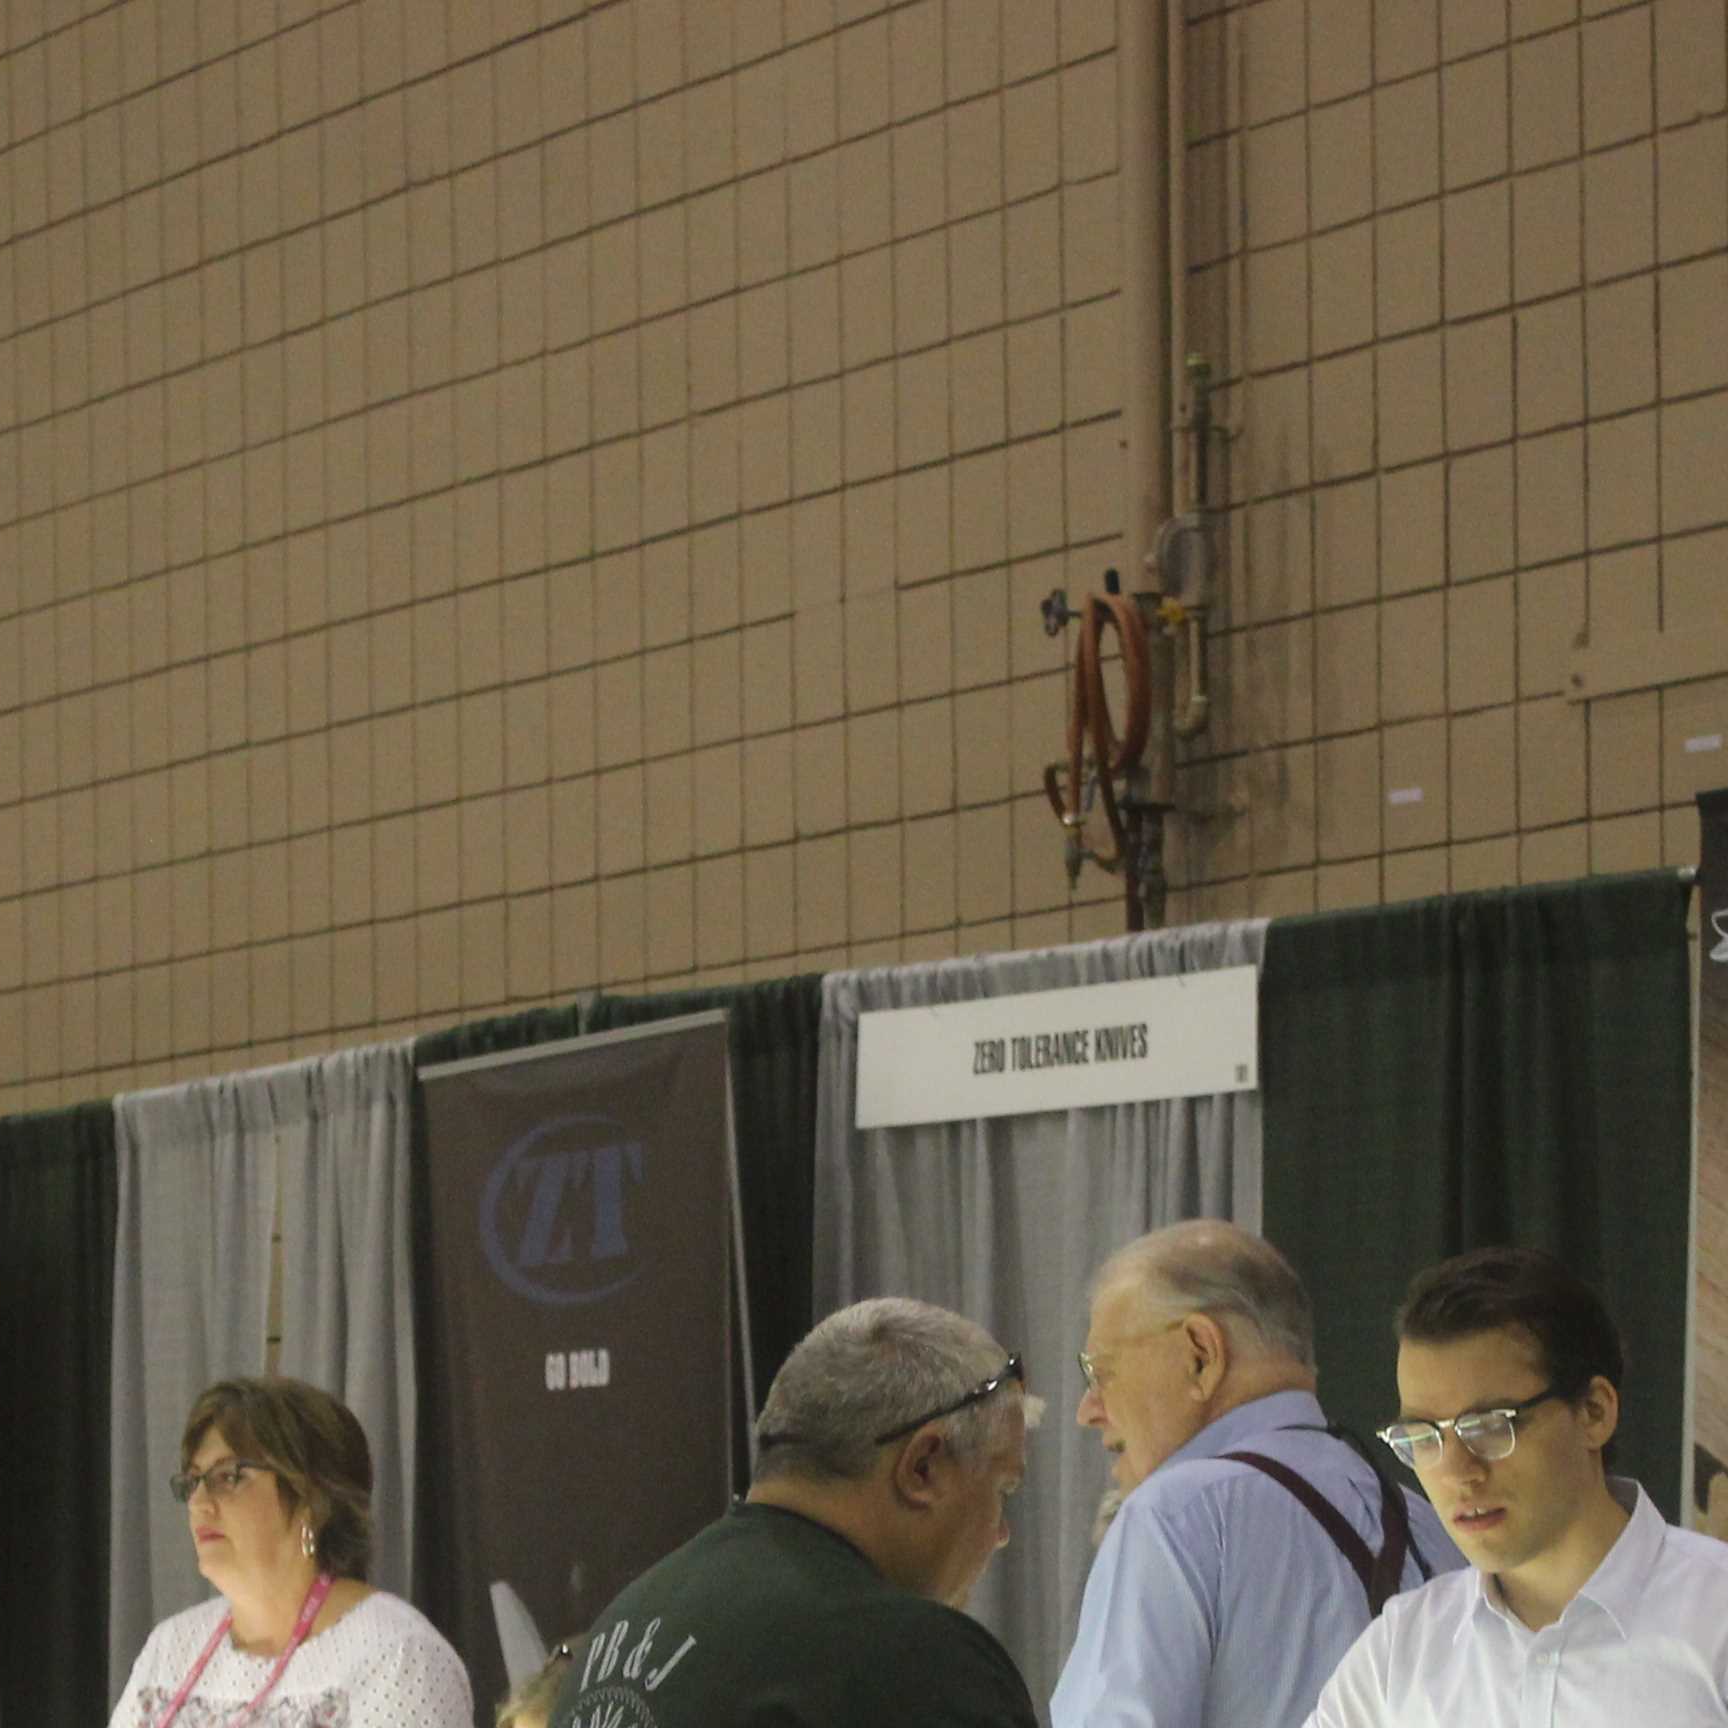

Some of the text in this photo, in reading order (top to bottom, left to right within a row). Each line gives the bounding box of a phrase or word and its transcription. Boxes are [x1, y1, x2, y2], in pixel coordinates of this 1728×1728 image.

[973, 1022, 1148, 1075] ZERO TOLERANCE KNIVES
